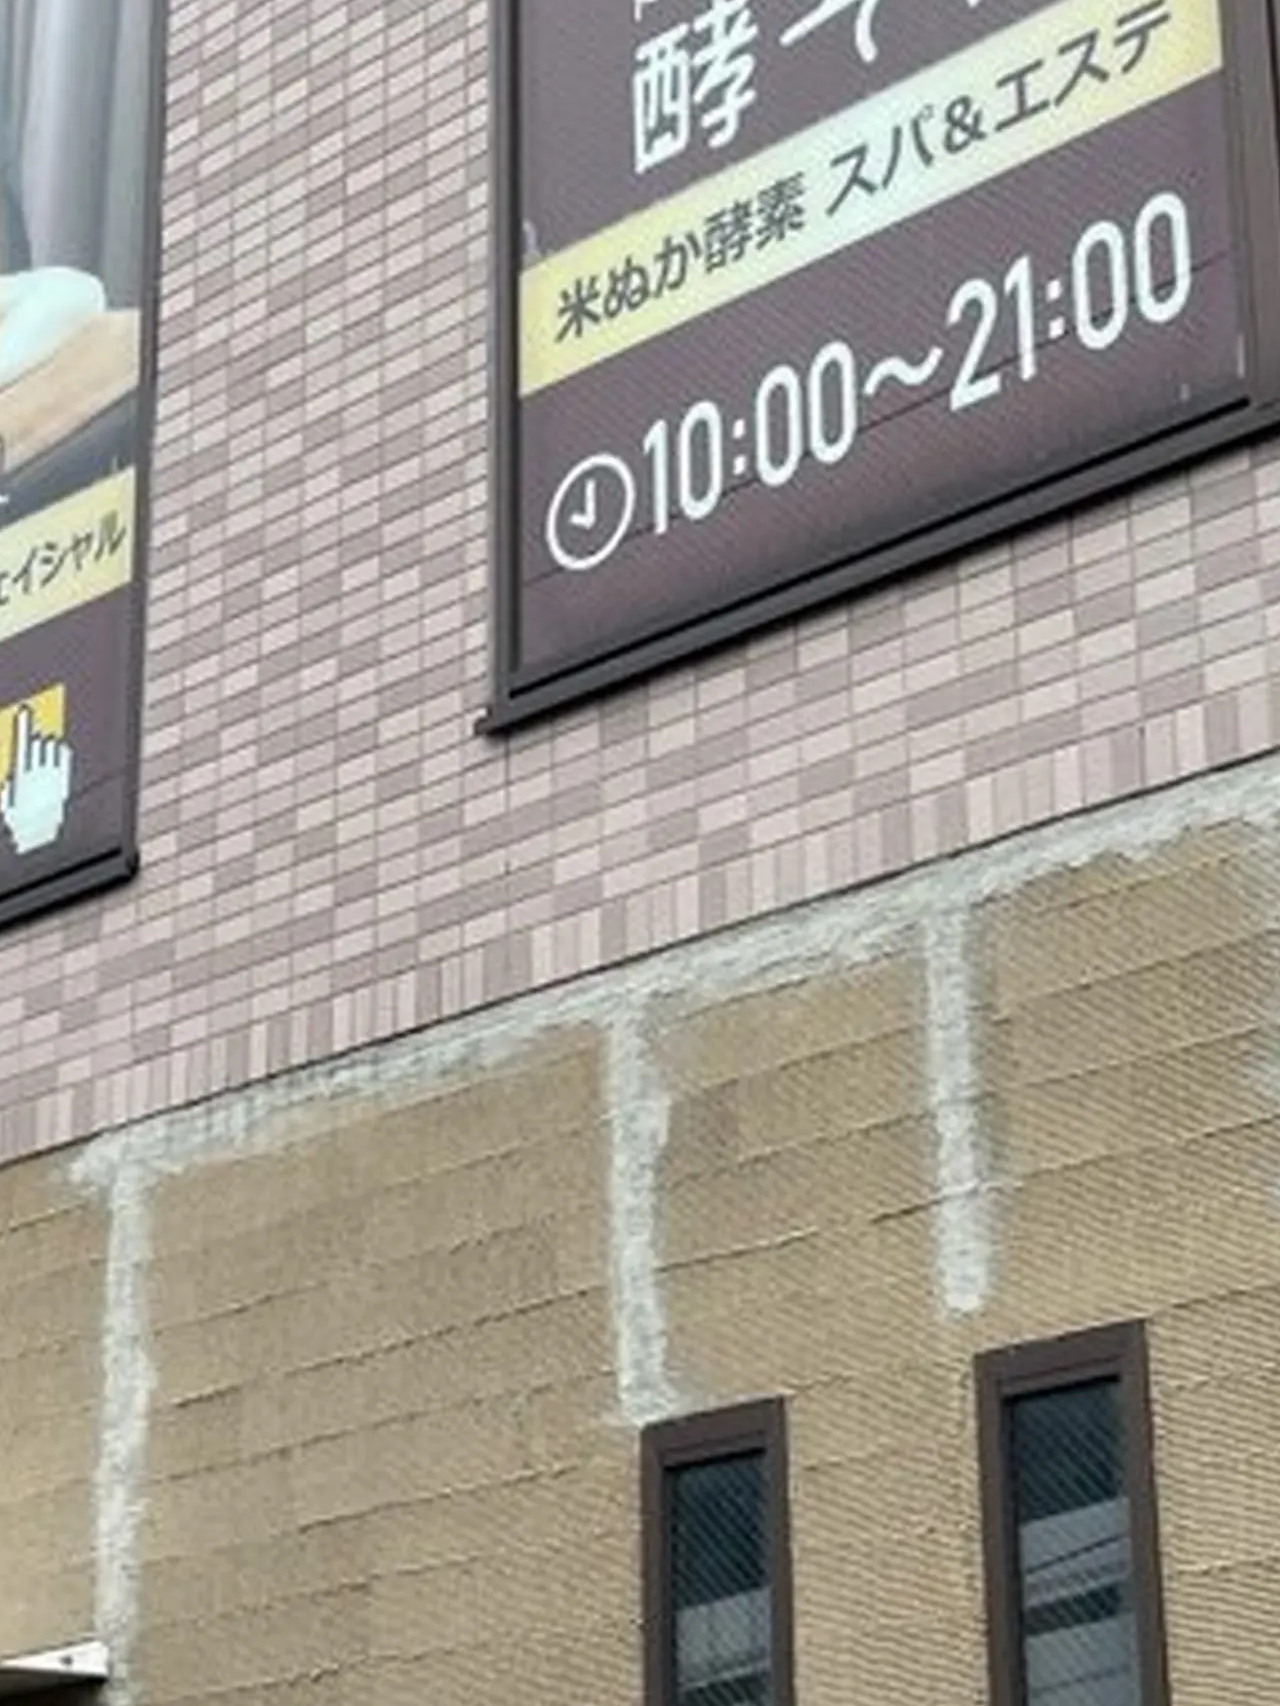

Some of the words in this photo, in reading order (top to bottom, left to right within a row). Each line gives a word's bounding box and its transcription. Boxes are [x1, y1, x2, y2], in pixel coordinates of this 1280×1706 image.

[554, 172, 805, 342] 米ぬか酵素
[645, 192, 1192, 535] 10:00〜21:00
